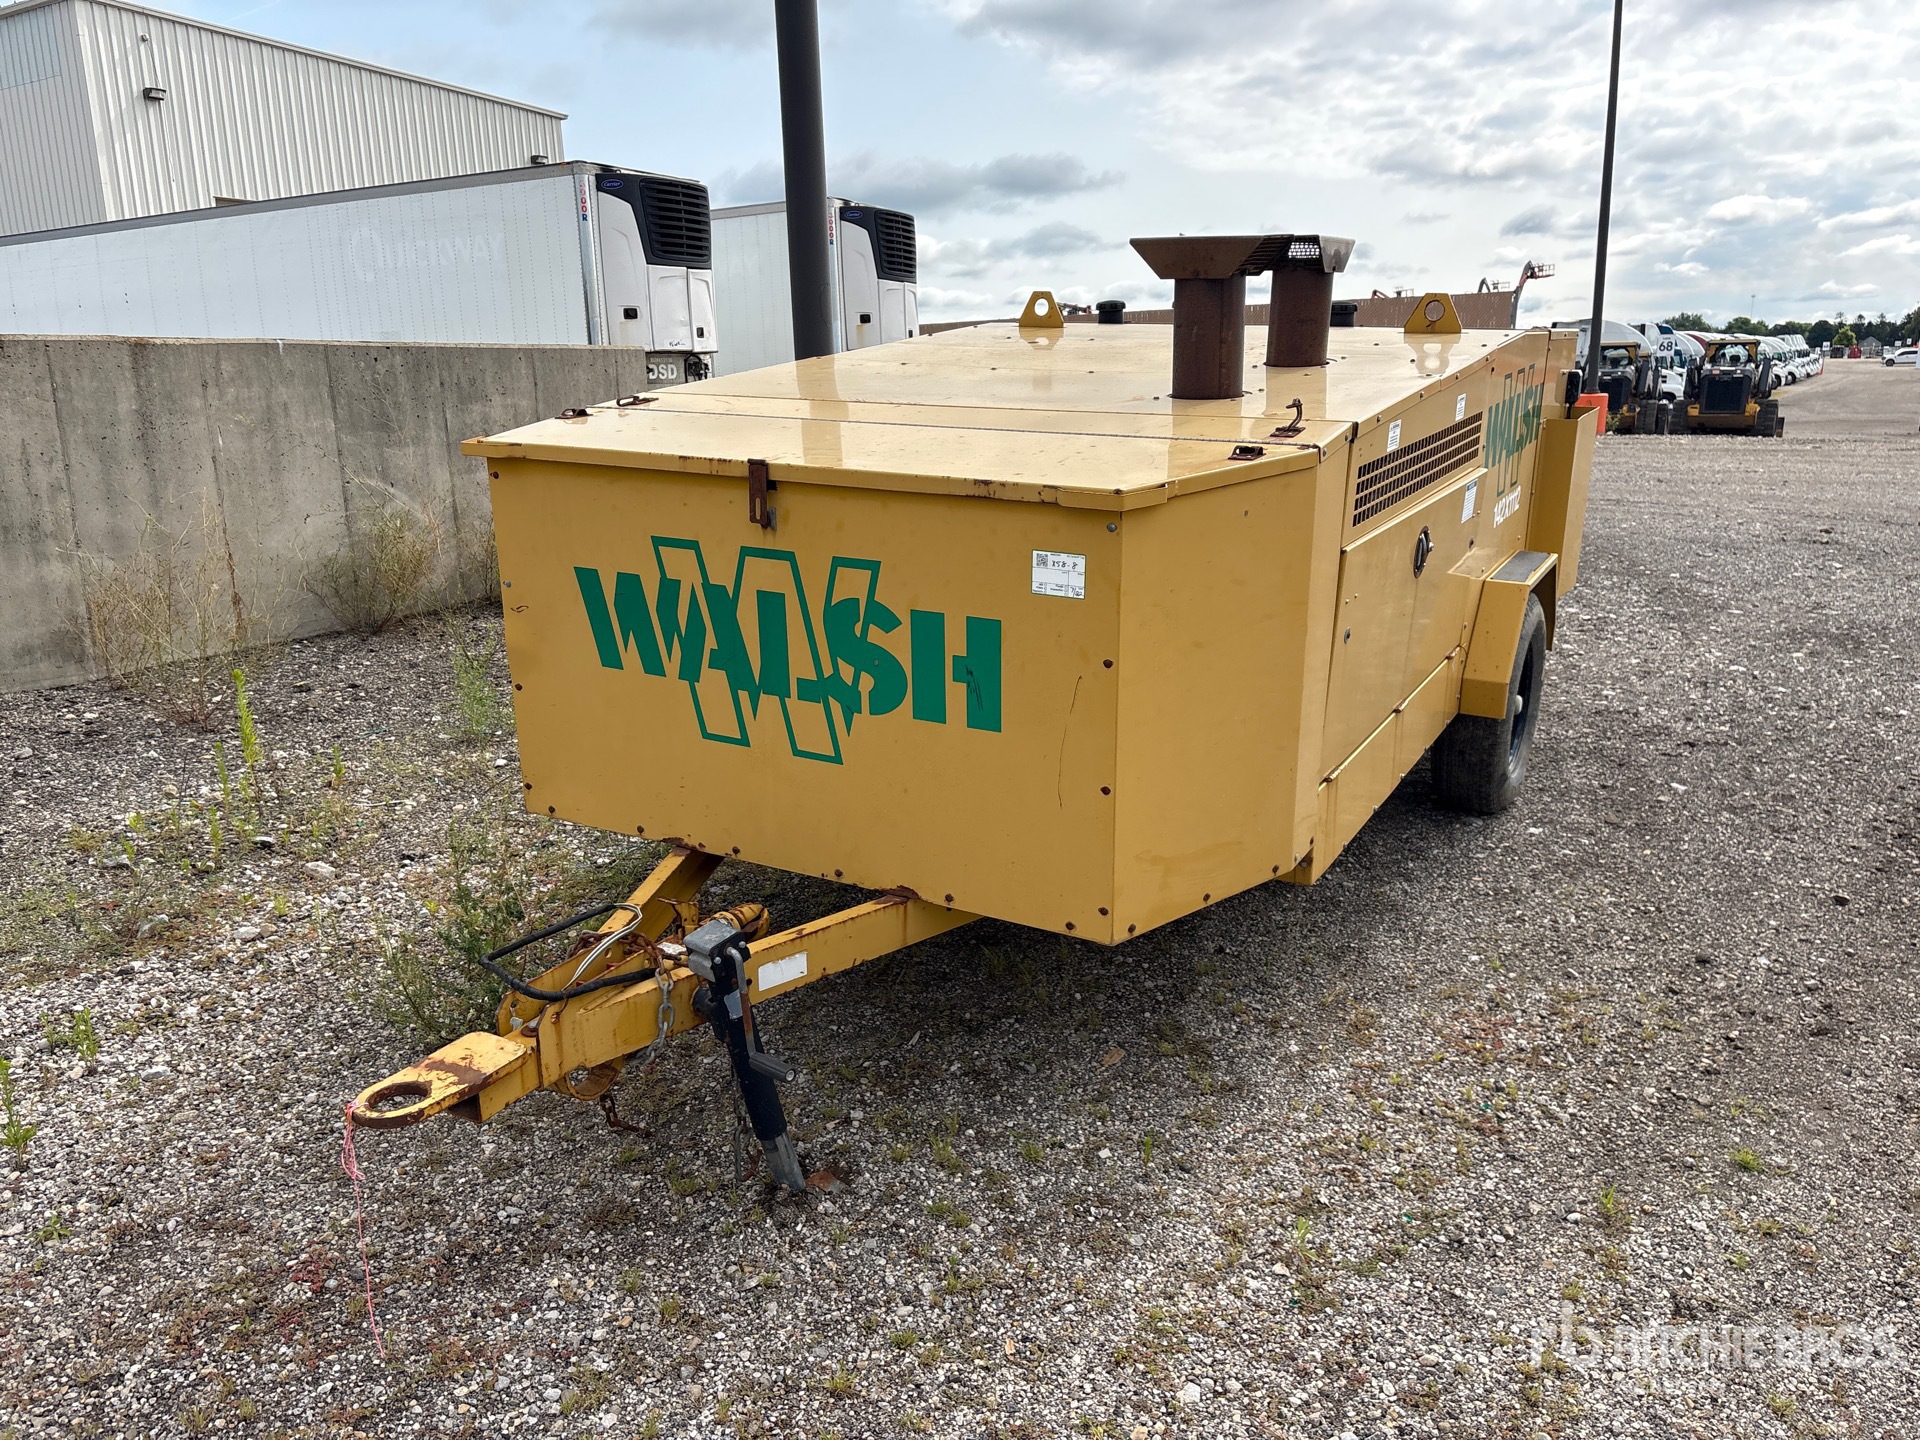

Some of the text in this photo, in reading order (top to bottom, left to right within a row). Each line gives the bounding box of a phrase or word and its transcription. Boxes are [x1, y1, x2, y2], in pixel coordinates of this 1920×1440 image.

[648, 363, 677, 380] DSD
[1659, 341, 1673, 352] 68
[1485, 382, 1544, 468] WALSH
[573, 566, 1002, 733] WALSH
